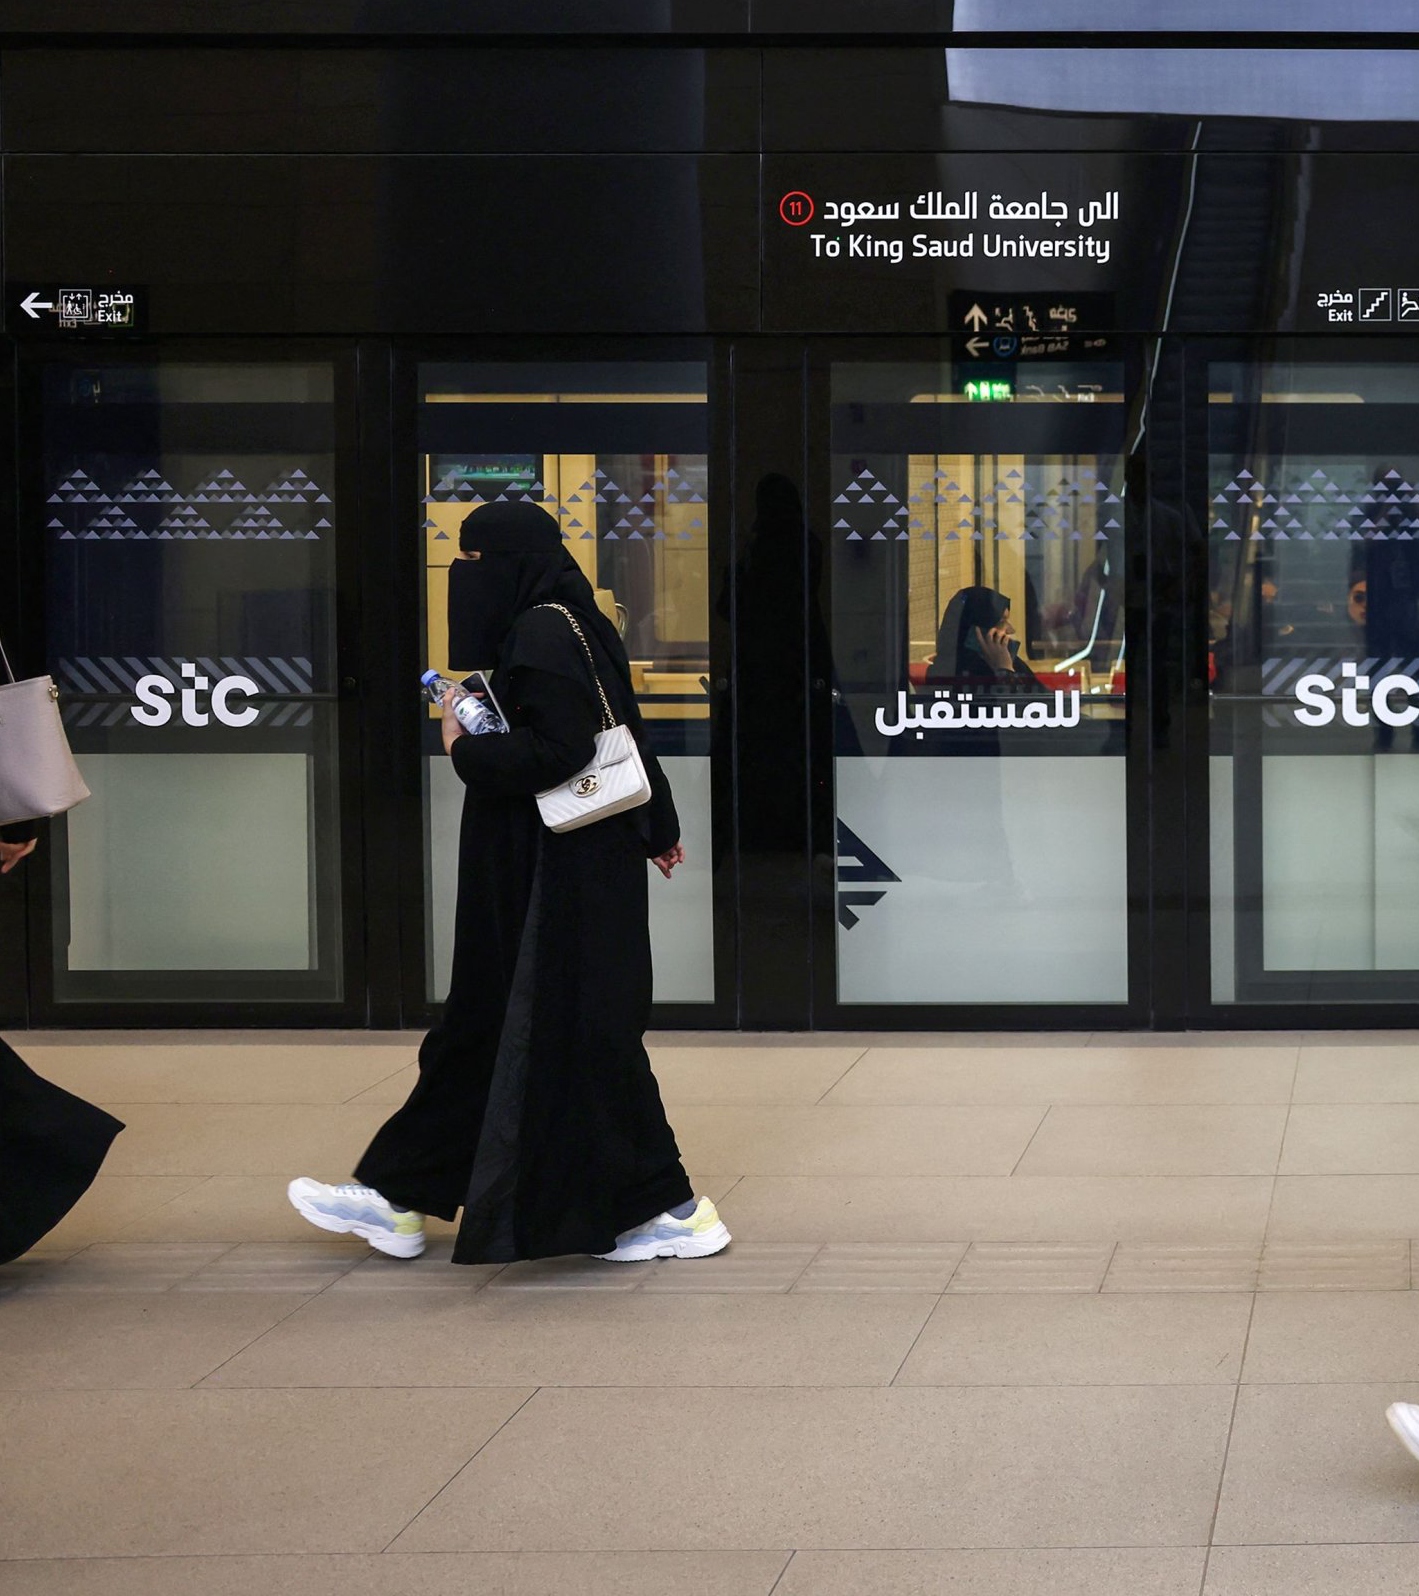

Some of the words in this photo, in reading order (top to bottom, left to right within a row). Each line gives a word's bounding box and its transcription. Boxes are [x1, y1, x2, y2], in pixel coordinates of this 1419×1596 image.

[788, 201, 802, 216] 11
[823, 200, 900, 227] سعود
[908, 190, 978, 220] الملك
[988, 191, 1069, 228] جامعة
[810, 234, 841, 258] To
[849, 233, 904, 263] King
[911, 233, 975, 258] Saud
[983, 233, 1111, 264] University
[97, 290, 134, 308] مخرج
[1316, 289, 1354, 308] مخرج
[97, 309, 122, 322] Exit
[1328, 308, 1353, 322] Exit
[130, 662, 260, 727] stc
[874, 689, 1081, 740] للمستقبل
